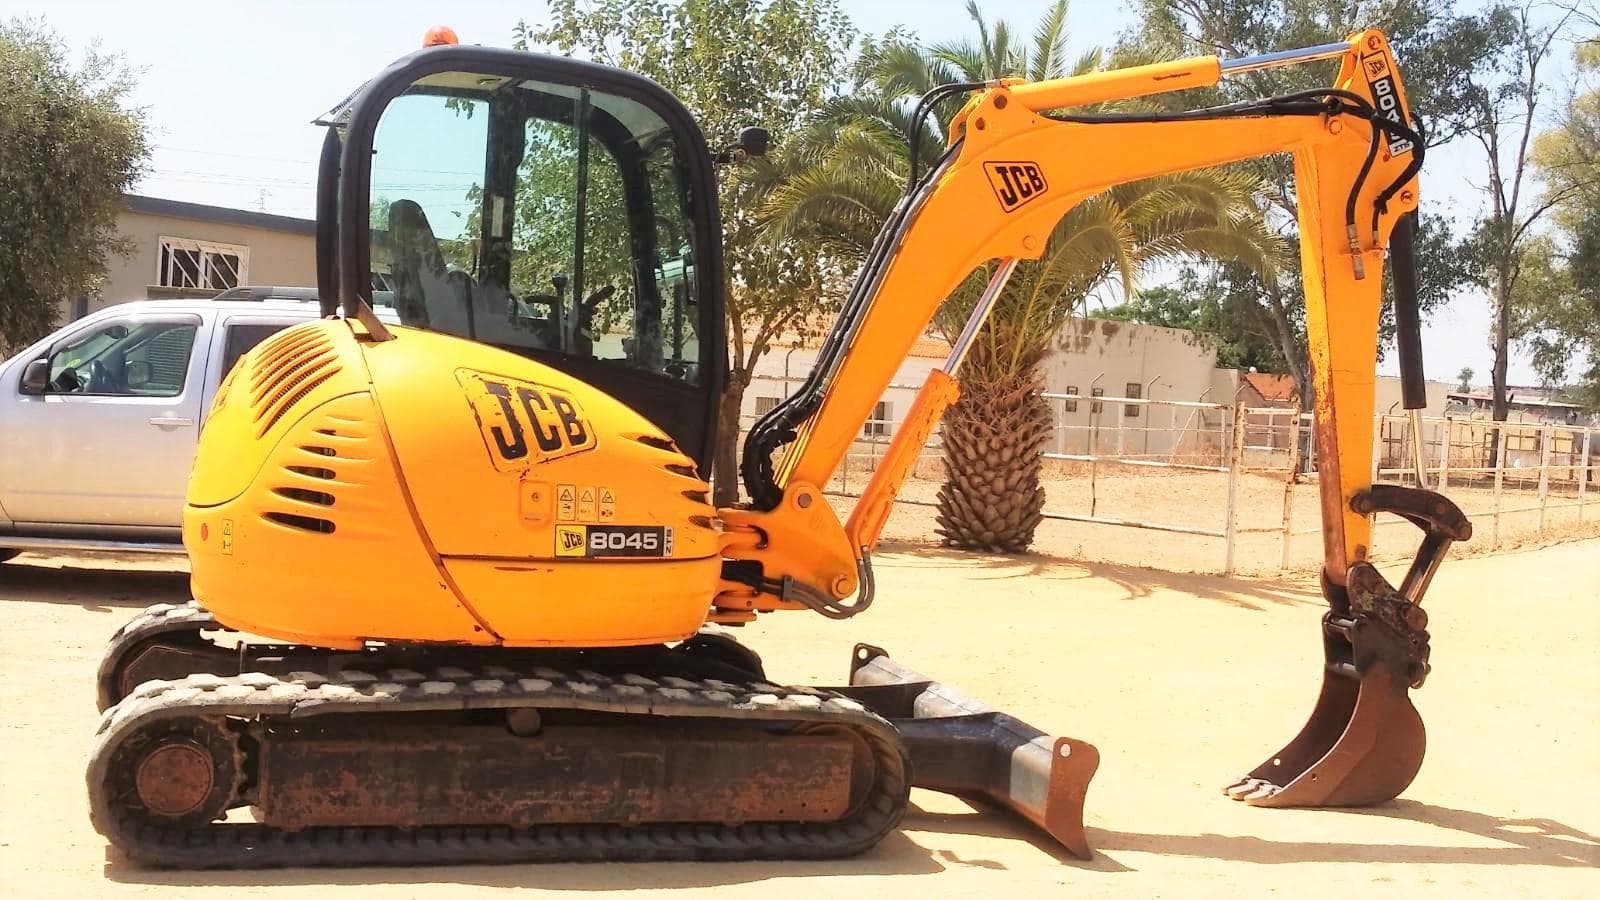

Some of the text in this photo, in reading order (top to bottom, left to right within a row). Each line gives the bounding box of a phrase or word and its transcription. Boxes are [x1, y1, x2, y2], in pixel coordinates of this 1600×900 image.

[1369, 60, 1386, 75] JCB
[994, 166, 1044, 207] JCB
[484, 380, 588, 460] JCB
[564, 532, 658, 550] JCB 8045
